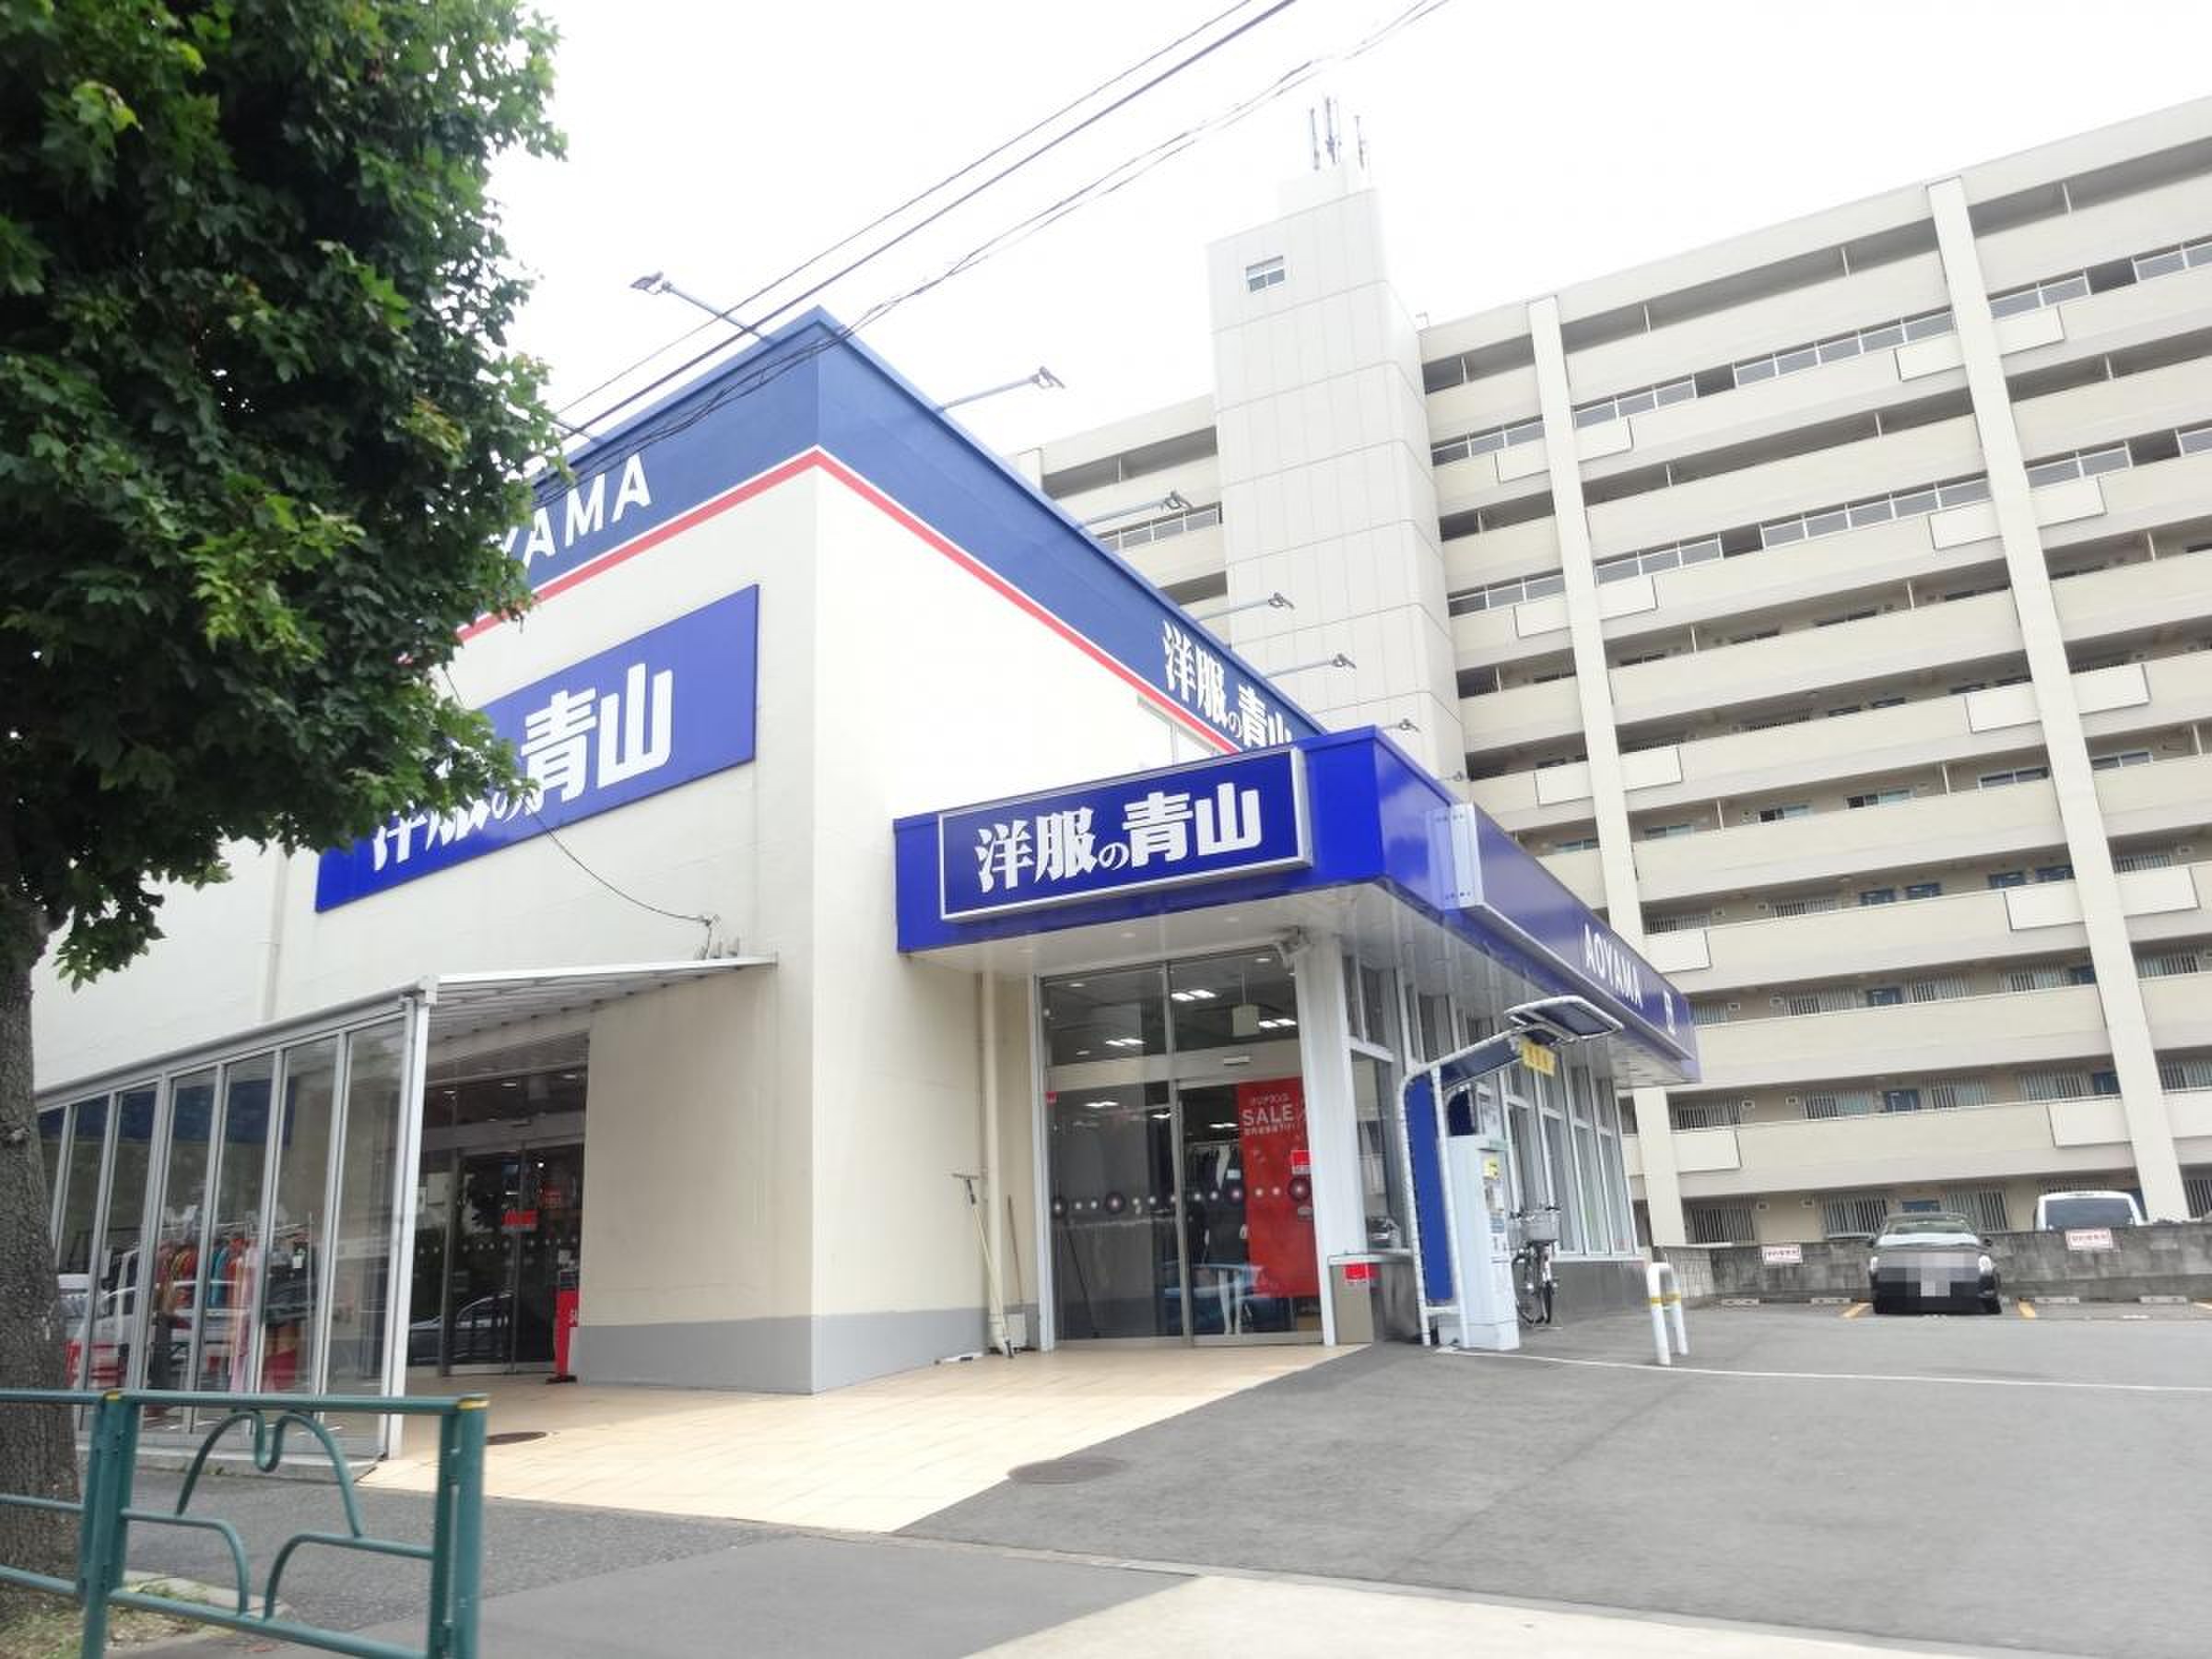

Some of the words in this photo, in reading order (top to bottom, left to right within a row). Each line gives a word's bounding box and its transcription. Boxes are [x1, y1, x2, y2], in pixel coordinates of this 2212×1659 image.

[974, 782, 1262, 892] 洋服の青山
[1584, 924, 1643, 1009] AOYAMA
[1241, 1104, 1294, 1126] SALE
